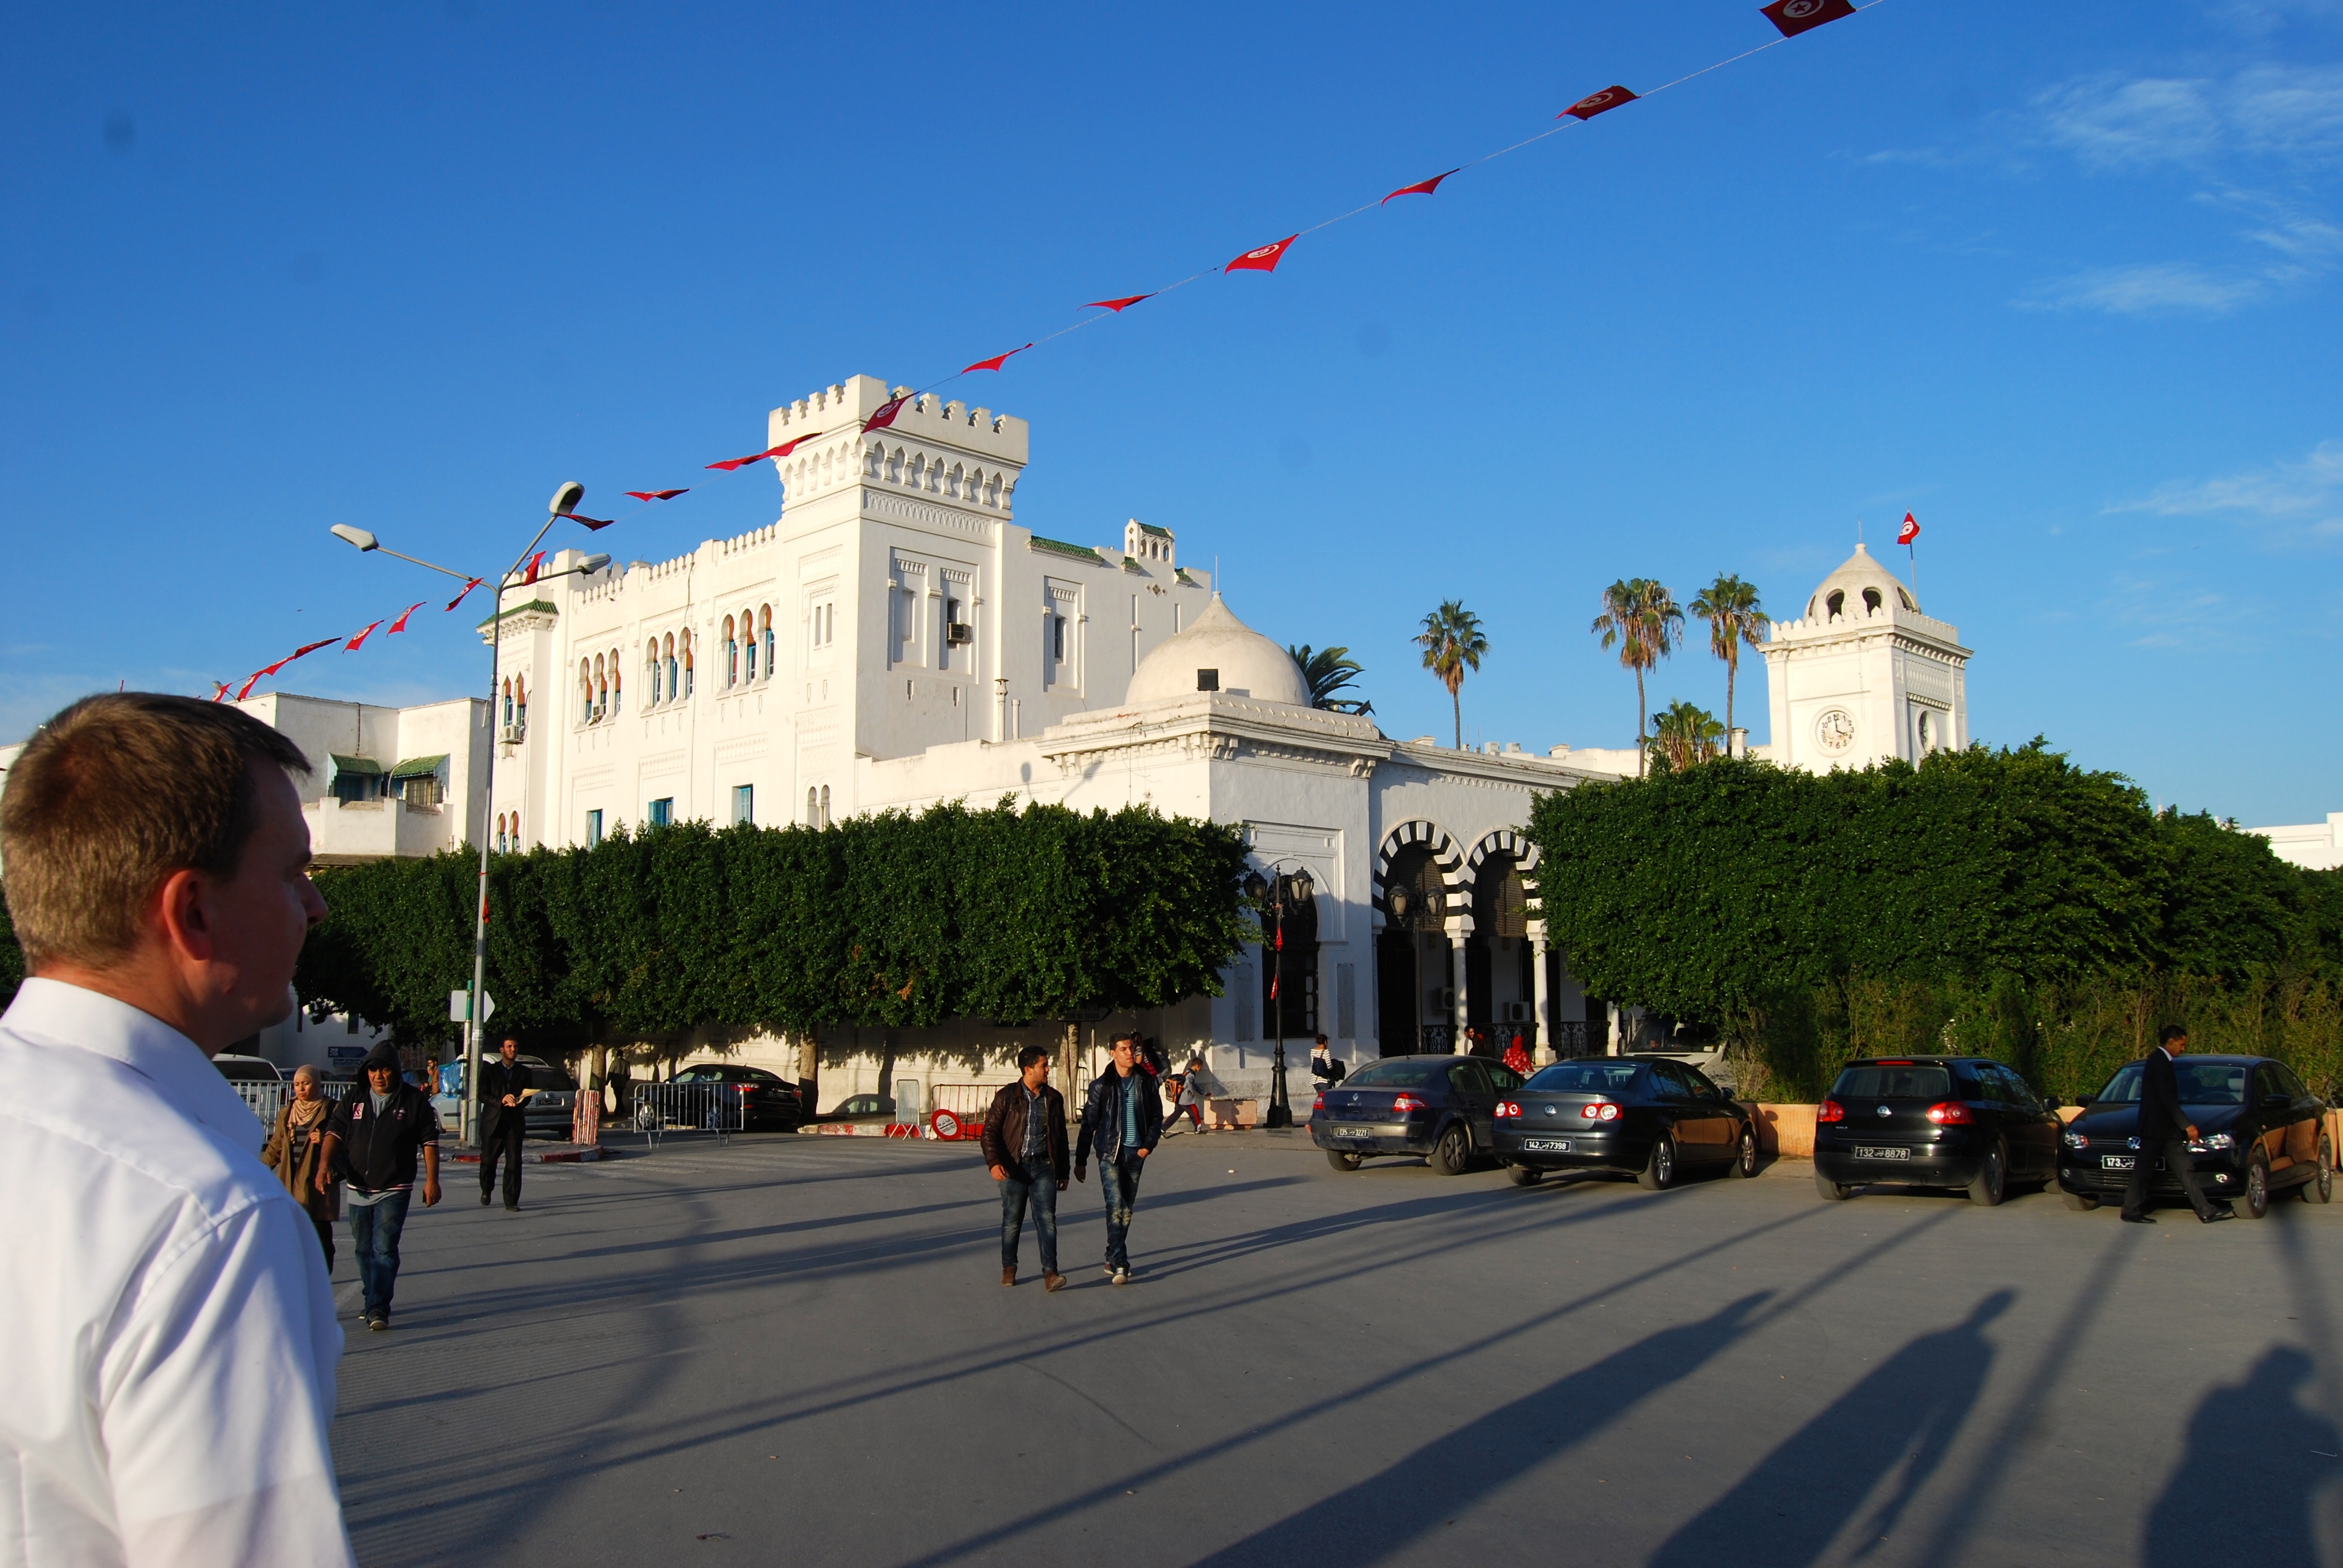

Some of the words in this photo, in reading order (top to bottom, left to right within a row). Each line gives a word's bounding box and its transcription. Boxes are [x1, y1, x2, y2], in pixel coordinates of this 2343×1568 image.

[1550, 1142, 1567, 1150] 7398
[1860, 1149, 1874, 1157] 132
[1884, 1149, 1906, 1158] 8878
[2106, 1157, 2121, 1167] 173
